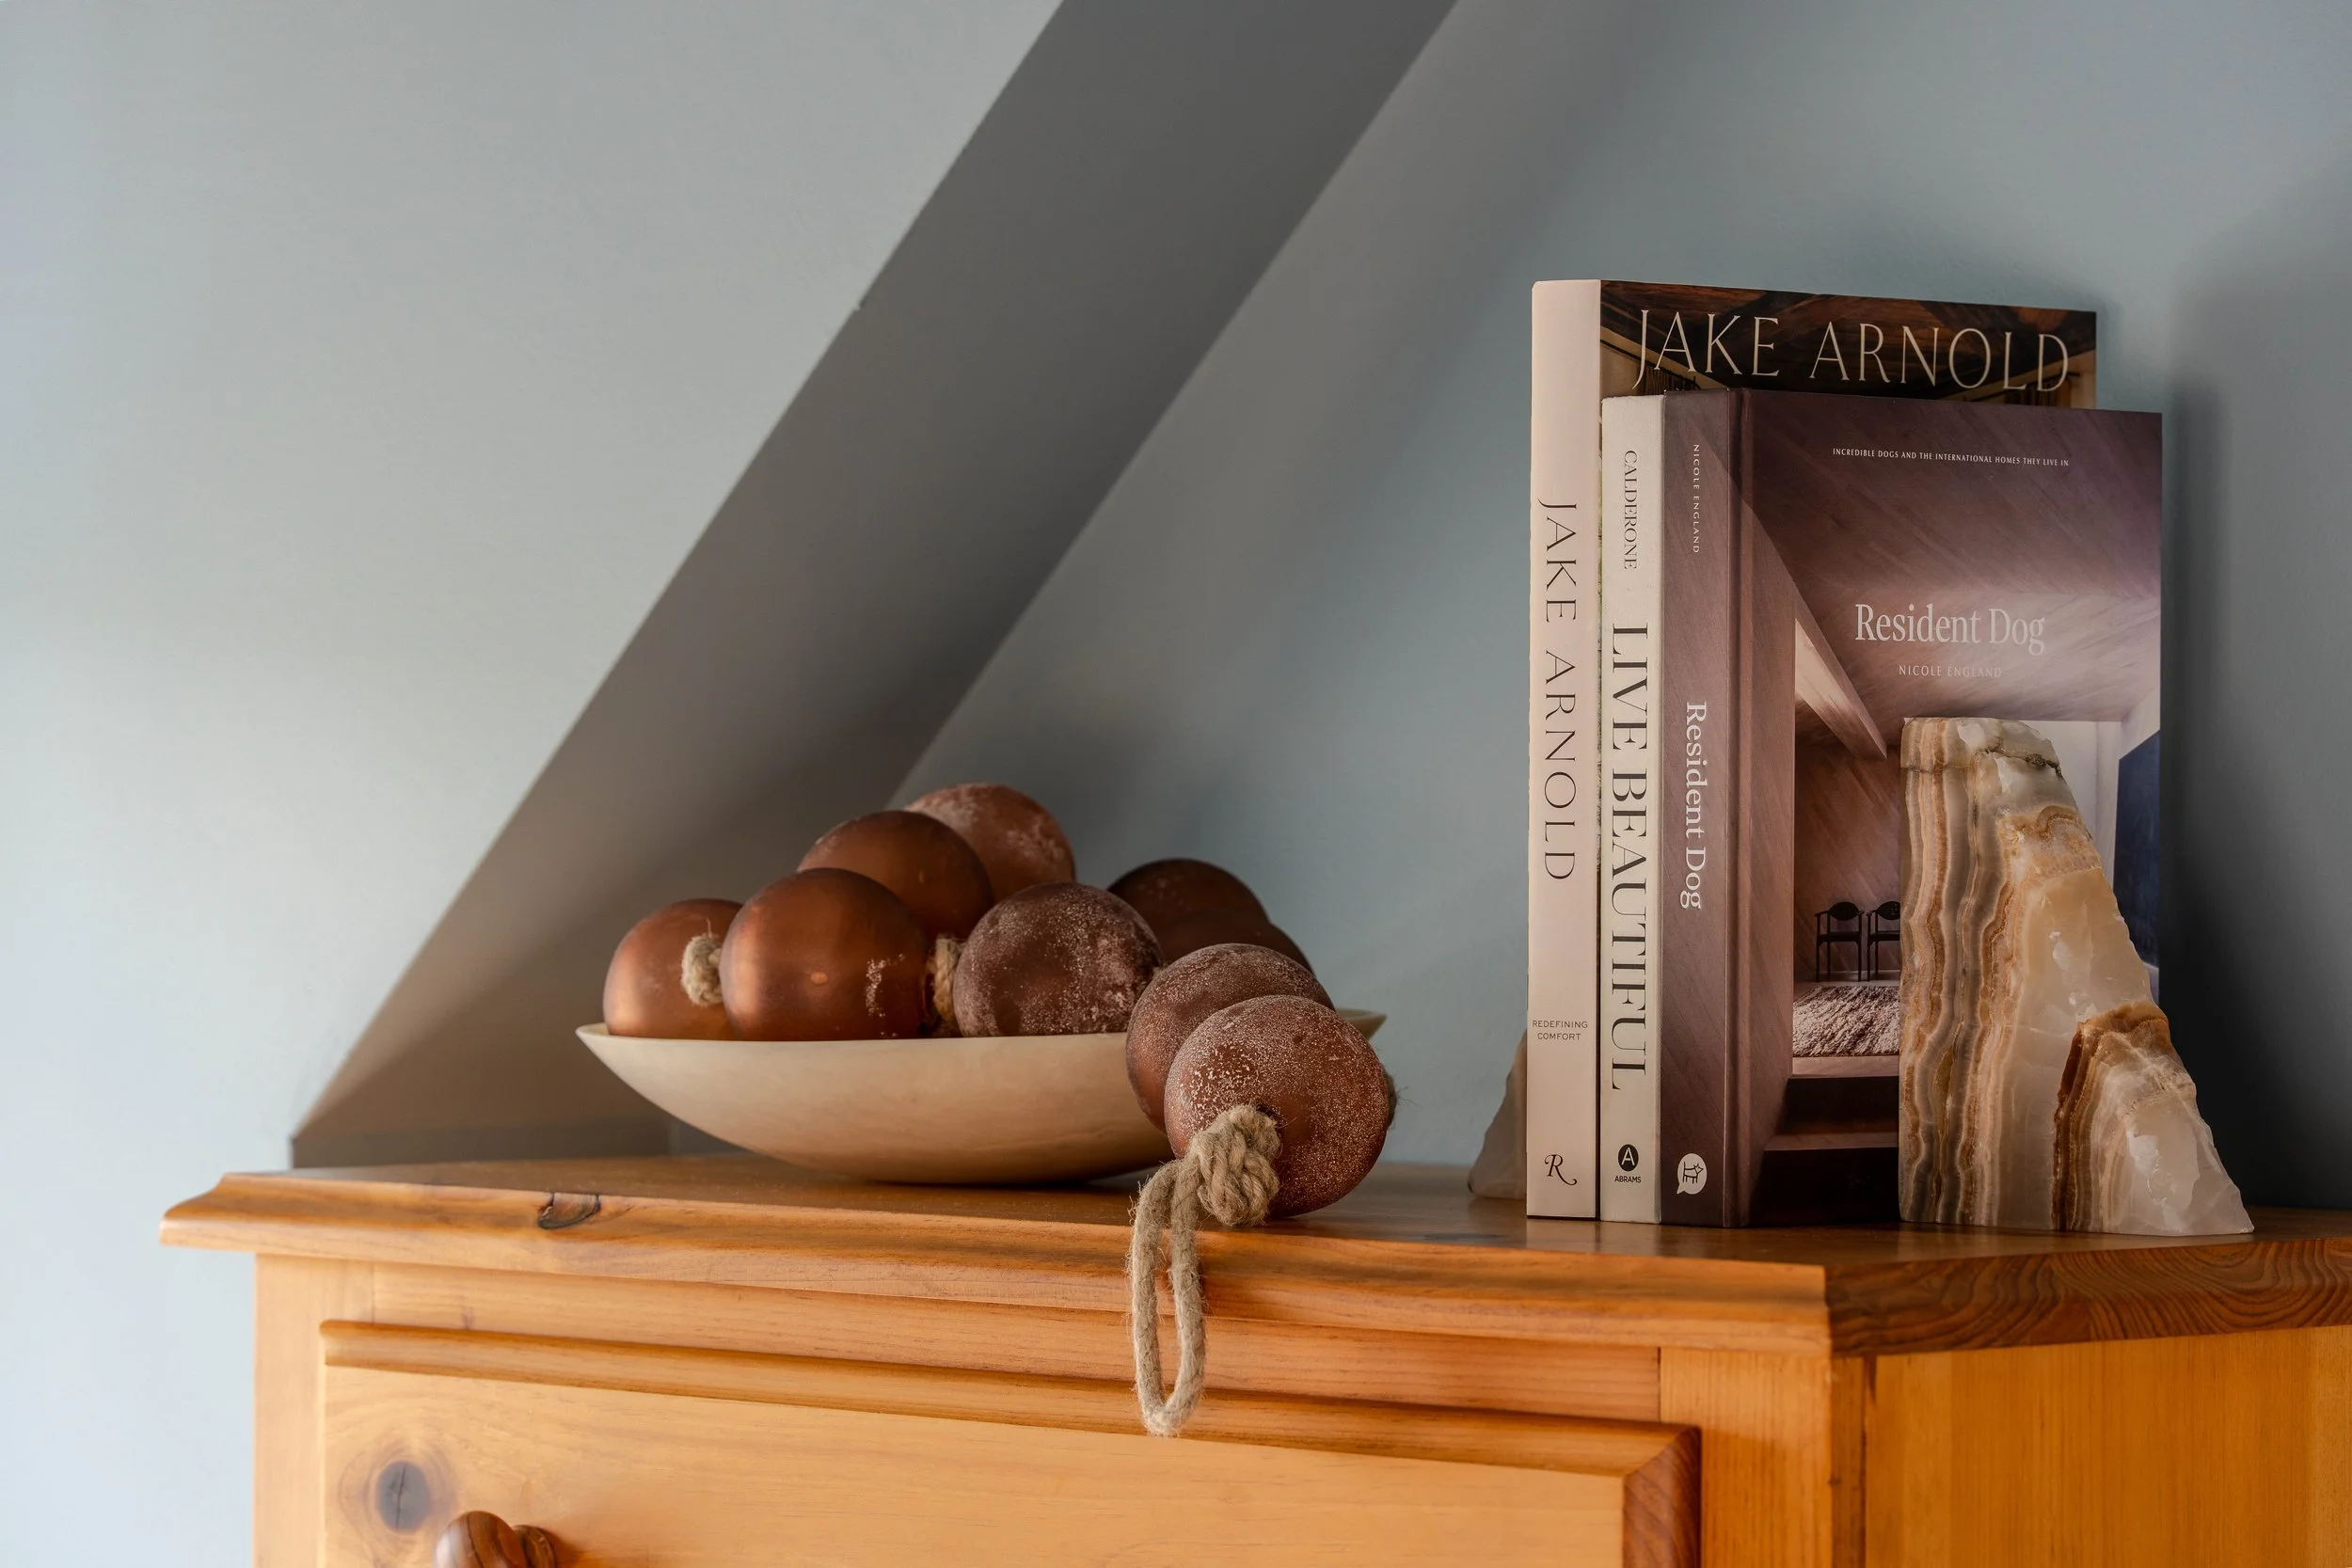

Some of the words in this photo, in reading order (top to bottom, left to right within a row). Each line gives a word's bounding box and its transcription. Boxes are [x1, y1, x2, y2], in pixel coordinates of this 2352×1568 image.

[1631, 309, 1780, 390] JAKE
[1808, 320, 2069, 392] ARNOLD
[1833, 448, 1875, 457] INCREDIBLE
[1878, 450, 1899, 458] DOGS
[1935, 453, 1993, 463] INTERNATIONAL
[2042, 458, 2058, 467] LIVE
[1624, 450, 1638, 570] CALDERONE
[1538, 499, 1577, 623] JAKE
[1854, 603, 1981, 643] Resident
[1988, 608, 2045, 656] Dog
[1612, 623, 1648, 751] LIVE
[1899, 665, 1942, 676] NICOLE
[1947, 666, 2002, 678] ENGLAND
[1544, 649, 1576, 879] ARNOLD
[1685, 702, 1708, 839] Resident
[1679, 847, 1707, 910] Dog
[1611, 768, 1647, 1090] BEAUTIFUL
[1533, 1020, 1588, 1029] REDEFINING
[1537, 1032, 1581, 1040] COMFORT
[1544, 1154, 1578, 1186] R
[1621, 1147, 1635, 1166] A
